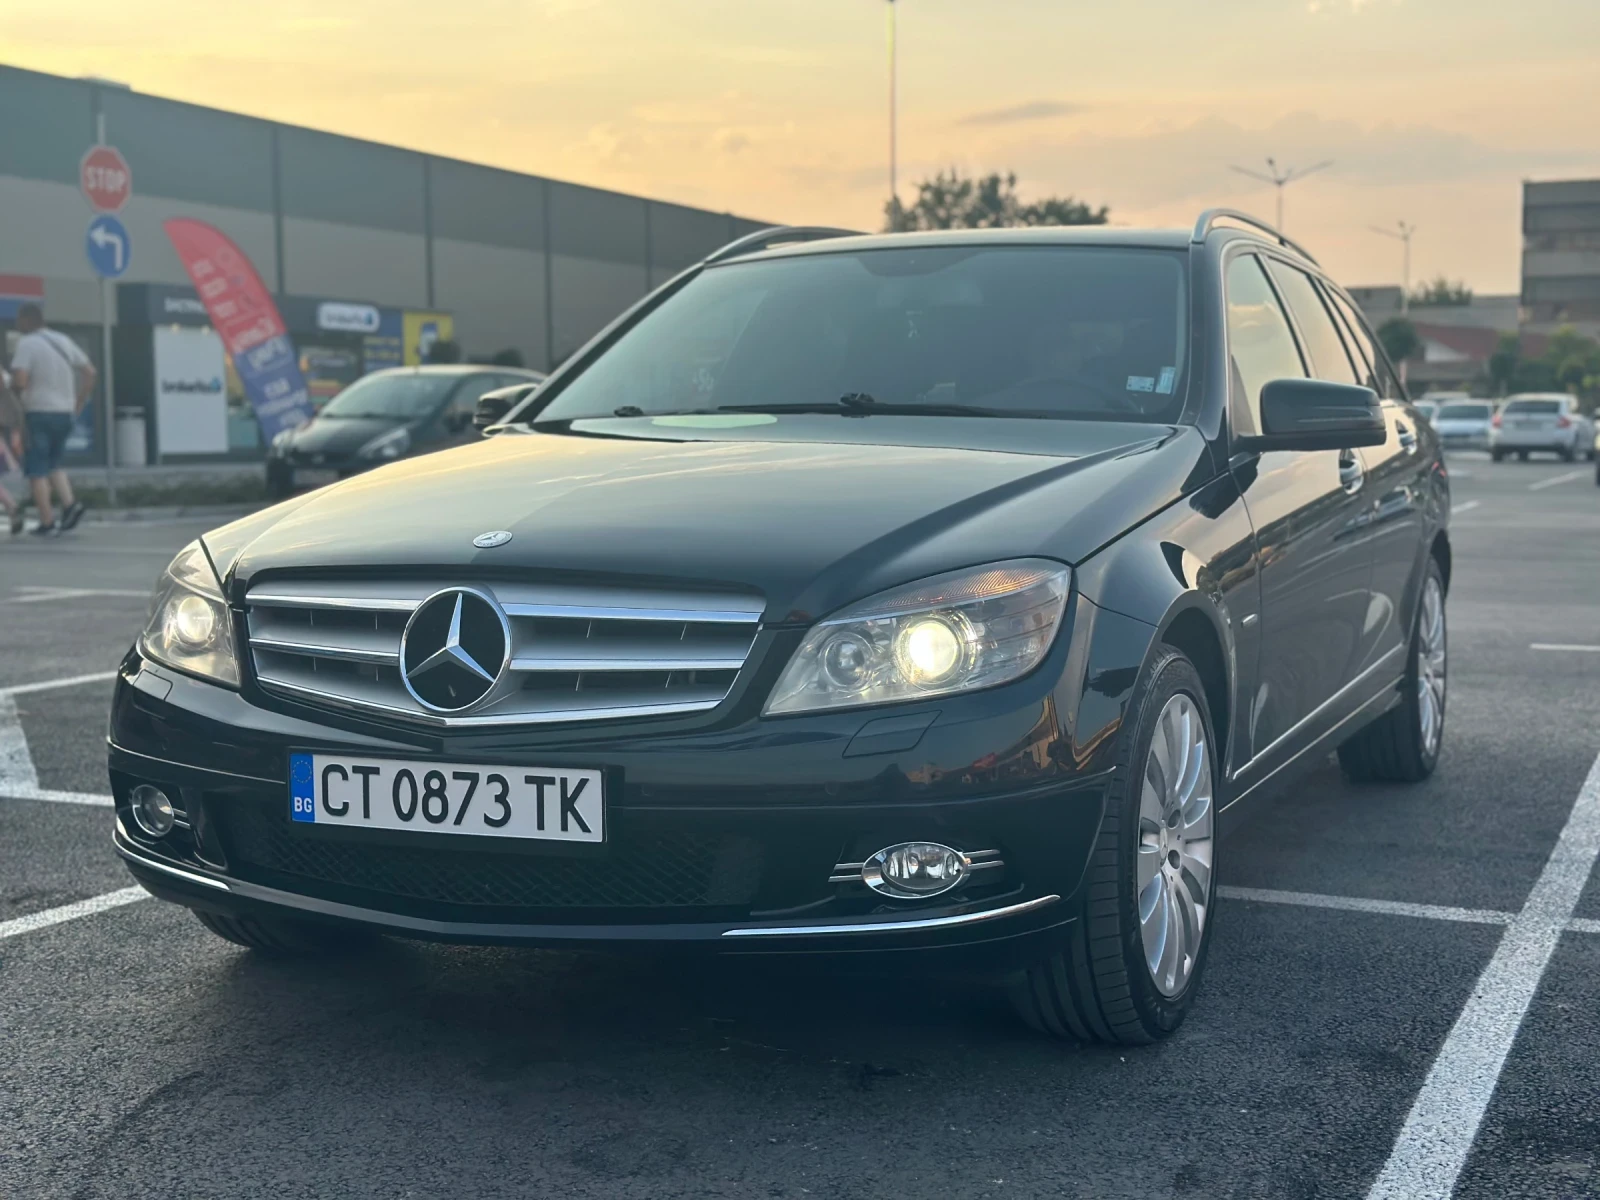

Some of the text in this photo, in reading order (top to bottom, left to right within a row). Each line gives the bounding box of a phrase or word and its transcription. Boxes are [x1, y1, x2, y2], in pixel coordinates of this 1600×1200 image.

[86, 166, 126, 193] STOP
[293, 796, 313, 814] BG
[321, 763, 593, 833] CT 0873 TK
